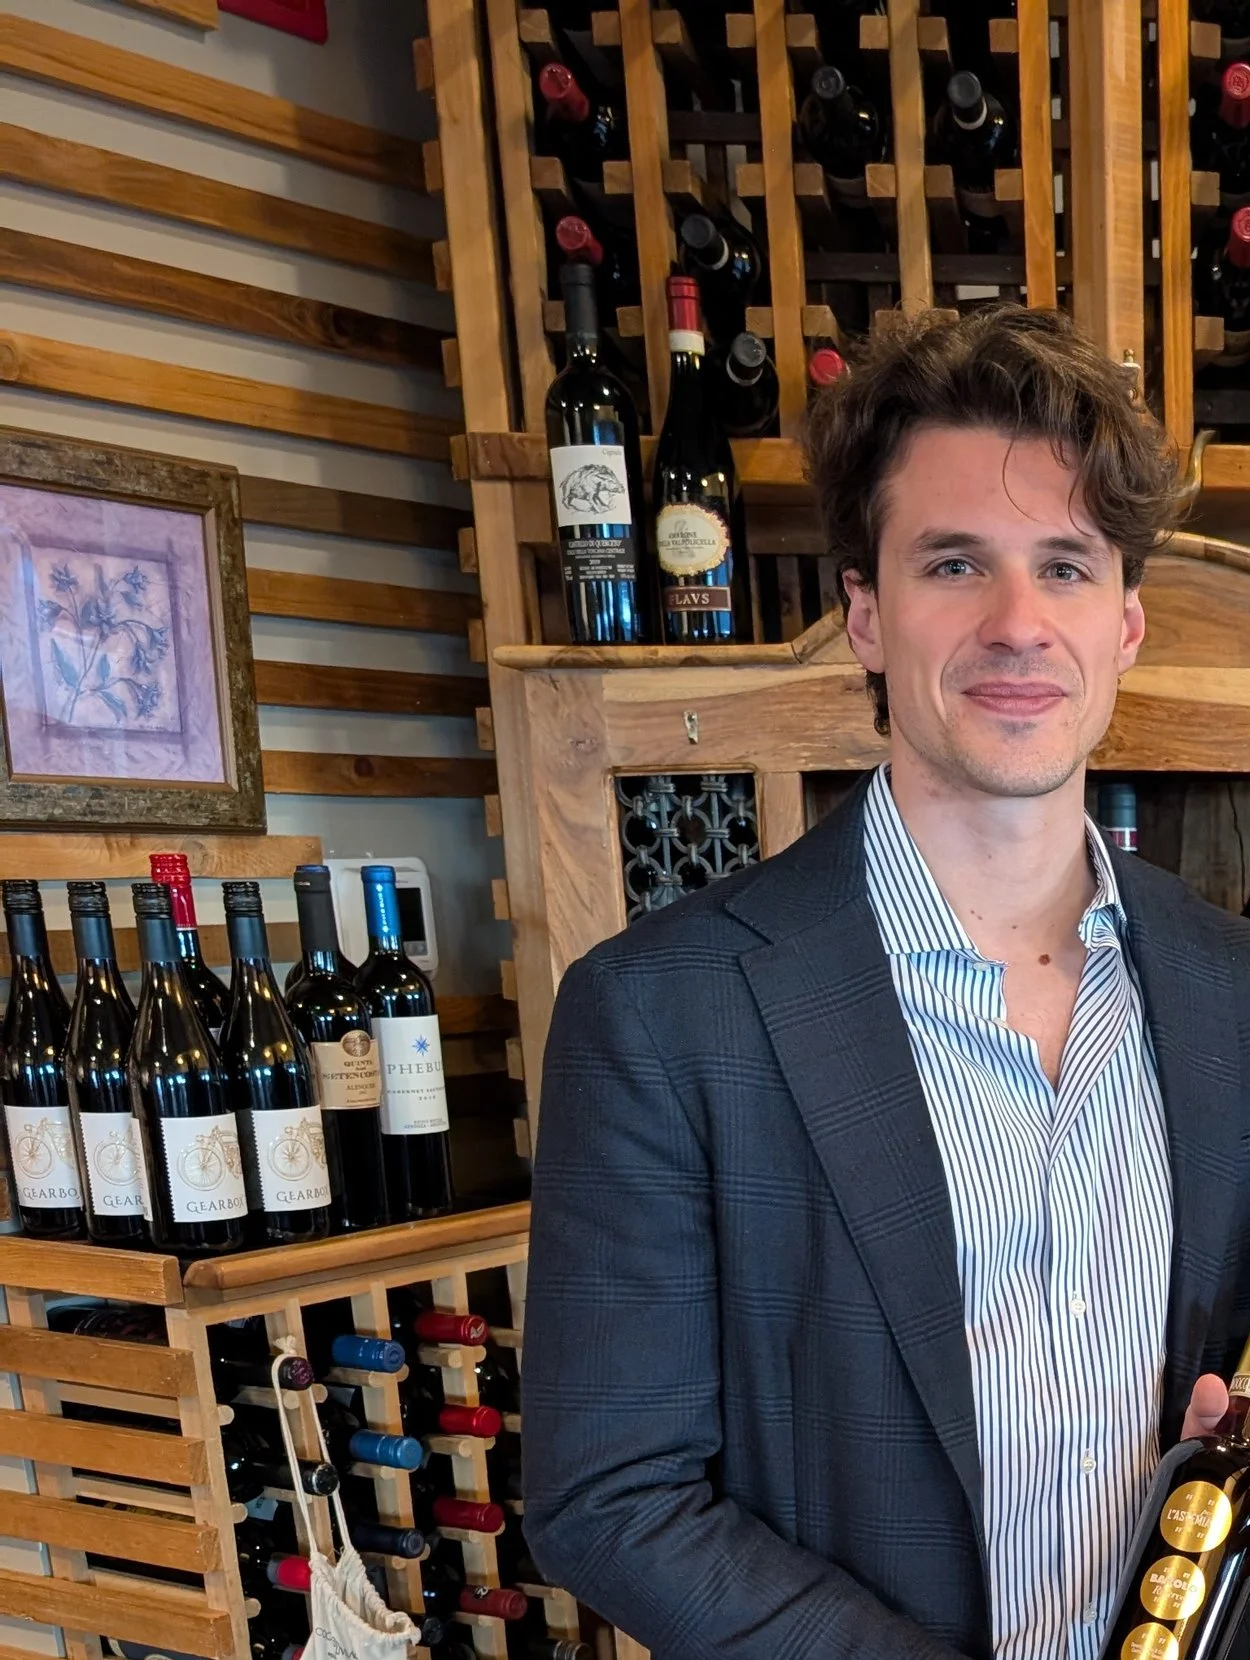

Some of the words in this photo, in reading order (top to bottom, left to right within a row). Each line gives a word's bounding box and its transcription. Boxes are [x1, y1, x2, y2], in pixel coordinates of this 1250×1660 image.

[386, 1061, 442, 1075] PHEBU
[23, 1187, 80, 1200] GEARBO
[276, 1185, 329, 1203] GEARBOX
[103, 1194, 143, 1208] GEAR
[186, 1196, 244, 1214] GEARBOX
